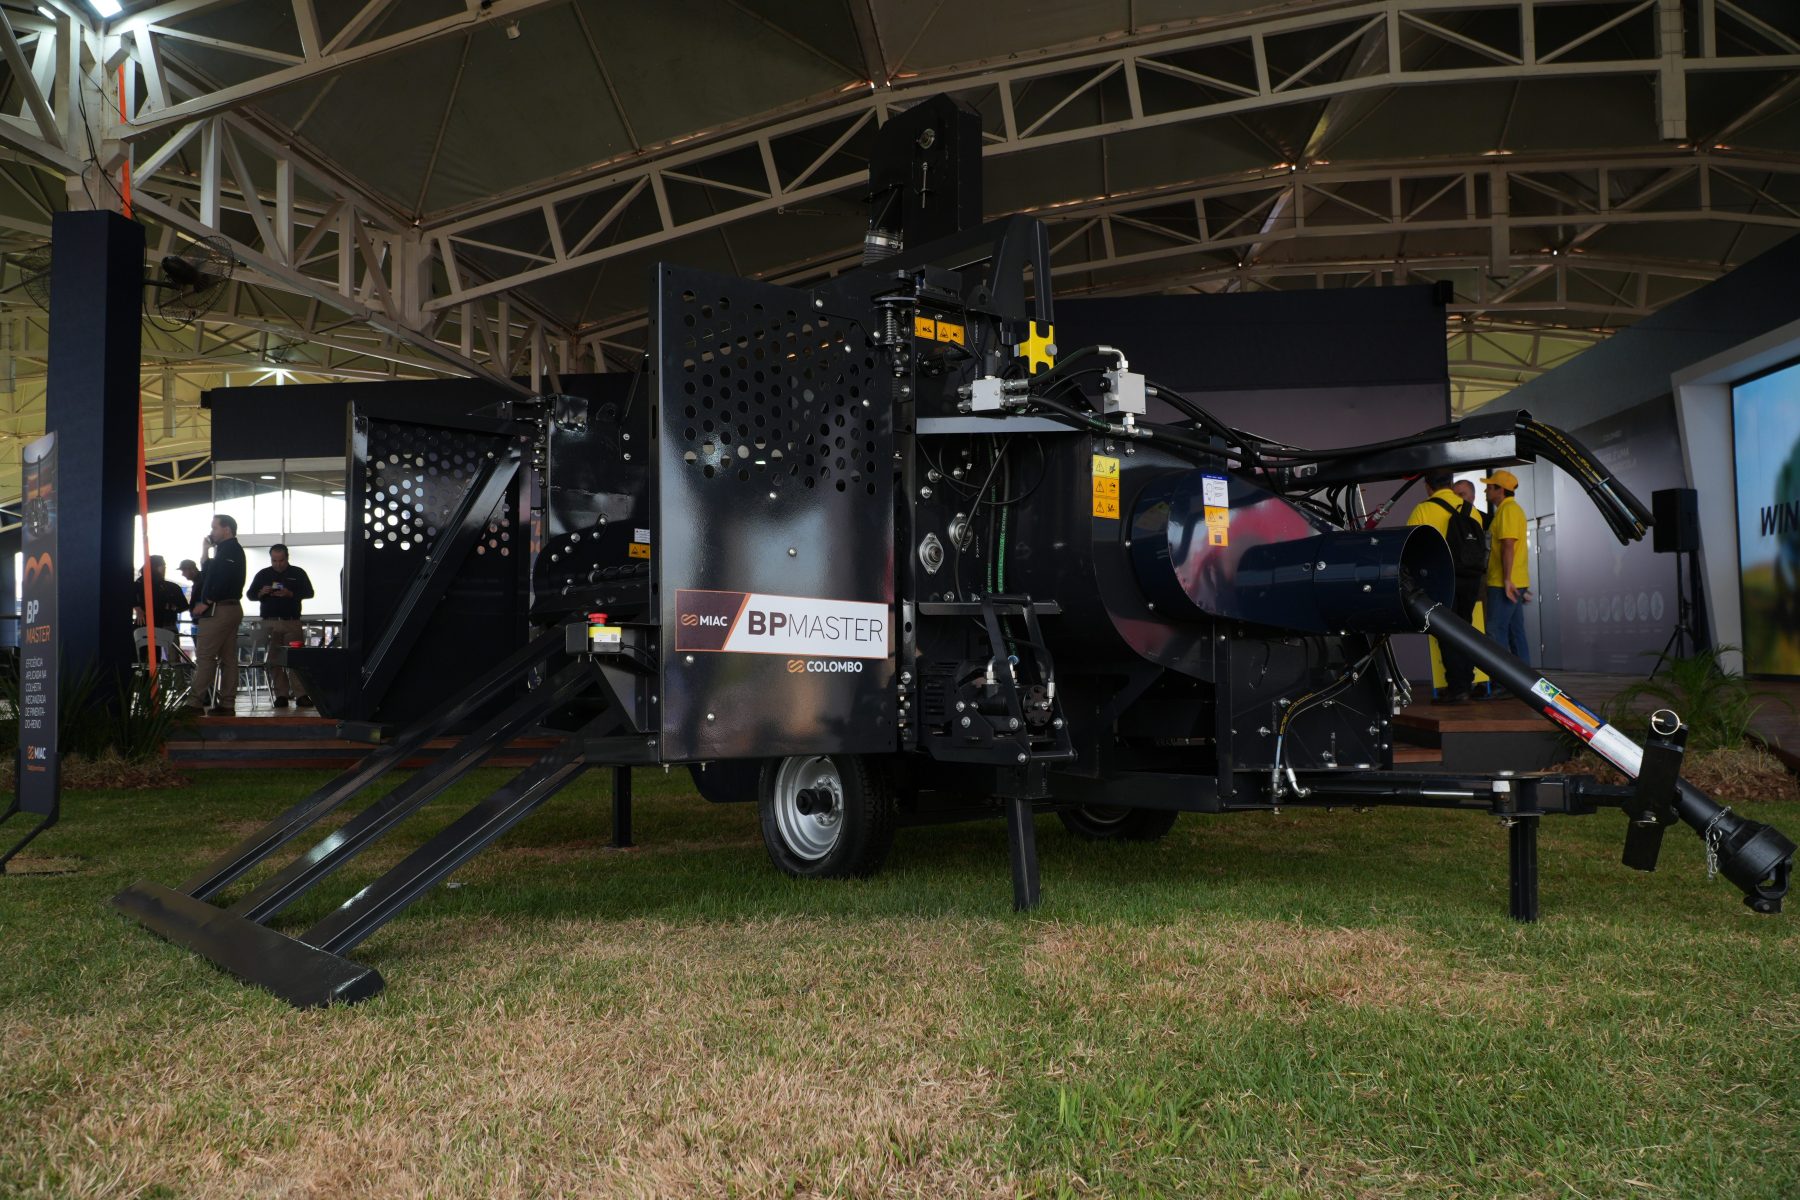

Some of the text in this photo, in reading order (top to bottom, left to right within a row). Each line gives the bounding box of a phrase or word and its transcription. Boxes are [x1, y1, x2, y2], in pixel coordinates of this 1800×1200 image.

[26, 600, 39, 624] BP
[699, 615, 728, 627] MIAC
[747, 610, 884, 643] BPMASTER
[26, 624, 51, 644] MASTER
[806, 660, 863, 673] COLOMBO
[34, 746, 47, 760] MIAC
